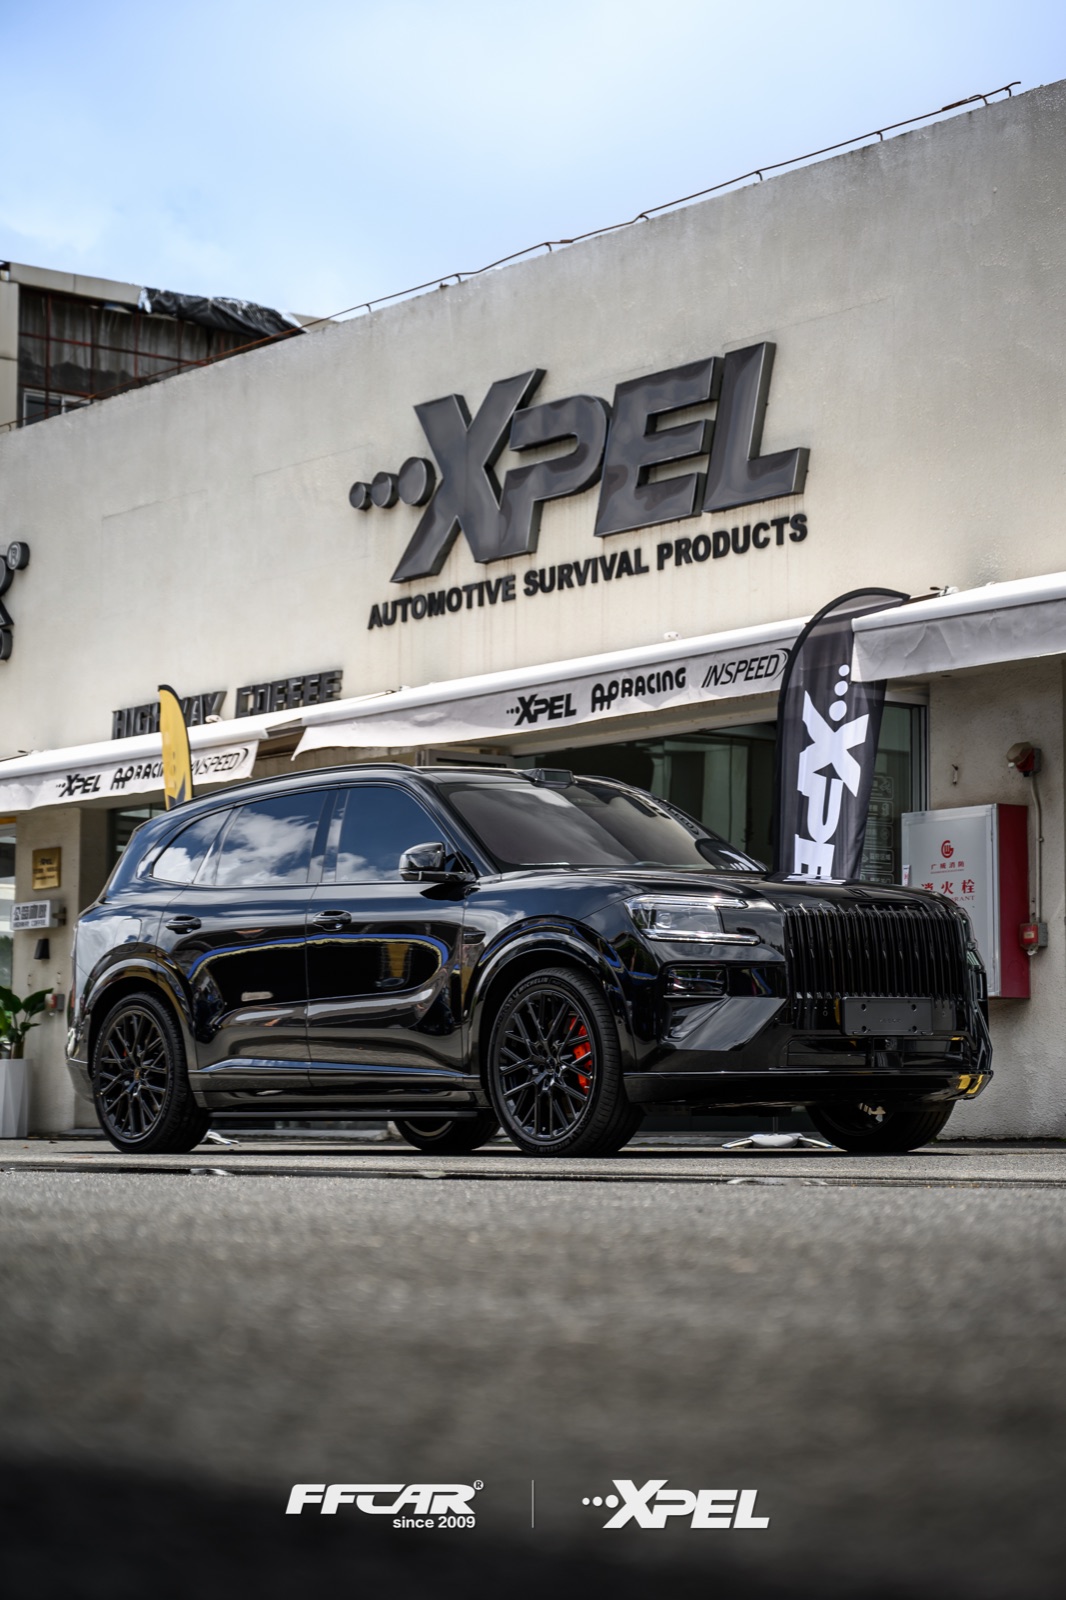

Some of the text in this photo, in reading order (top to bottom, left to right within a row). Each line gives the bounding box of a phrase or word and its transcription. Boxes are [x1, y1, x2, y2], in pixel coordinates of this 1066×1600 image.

[390, 341, 810, 583] XPEL
[368, 513, 808, 630] AUTOMOTIVE SURVIVAL PRODUCTS
[235, 670, 343, 719] COFFEE
[701, 653, 780, 688] INSPEED
[514, 692, 577, 726] XPEL
[58, 774, 101, 797] XPEL
[794, 690, 870, 878] XPE
